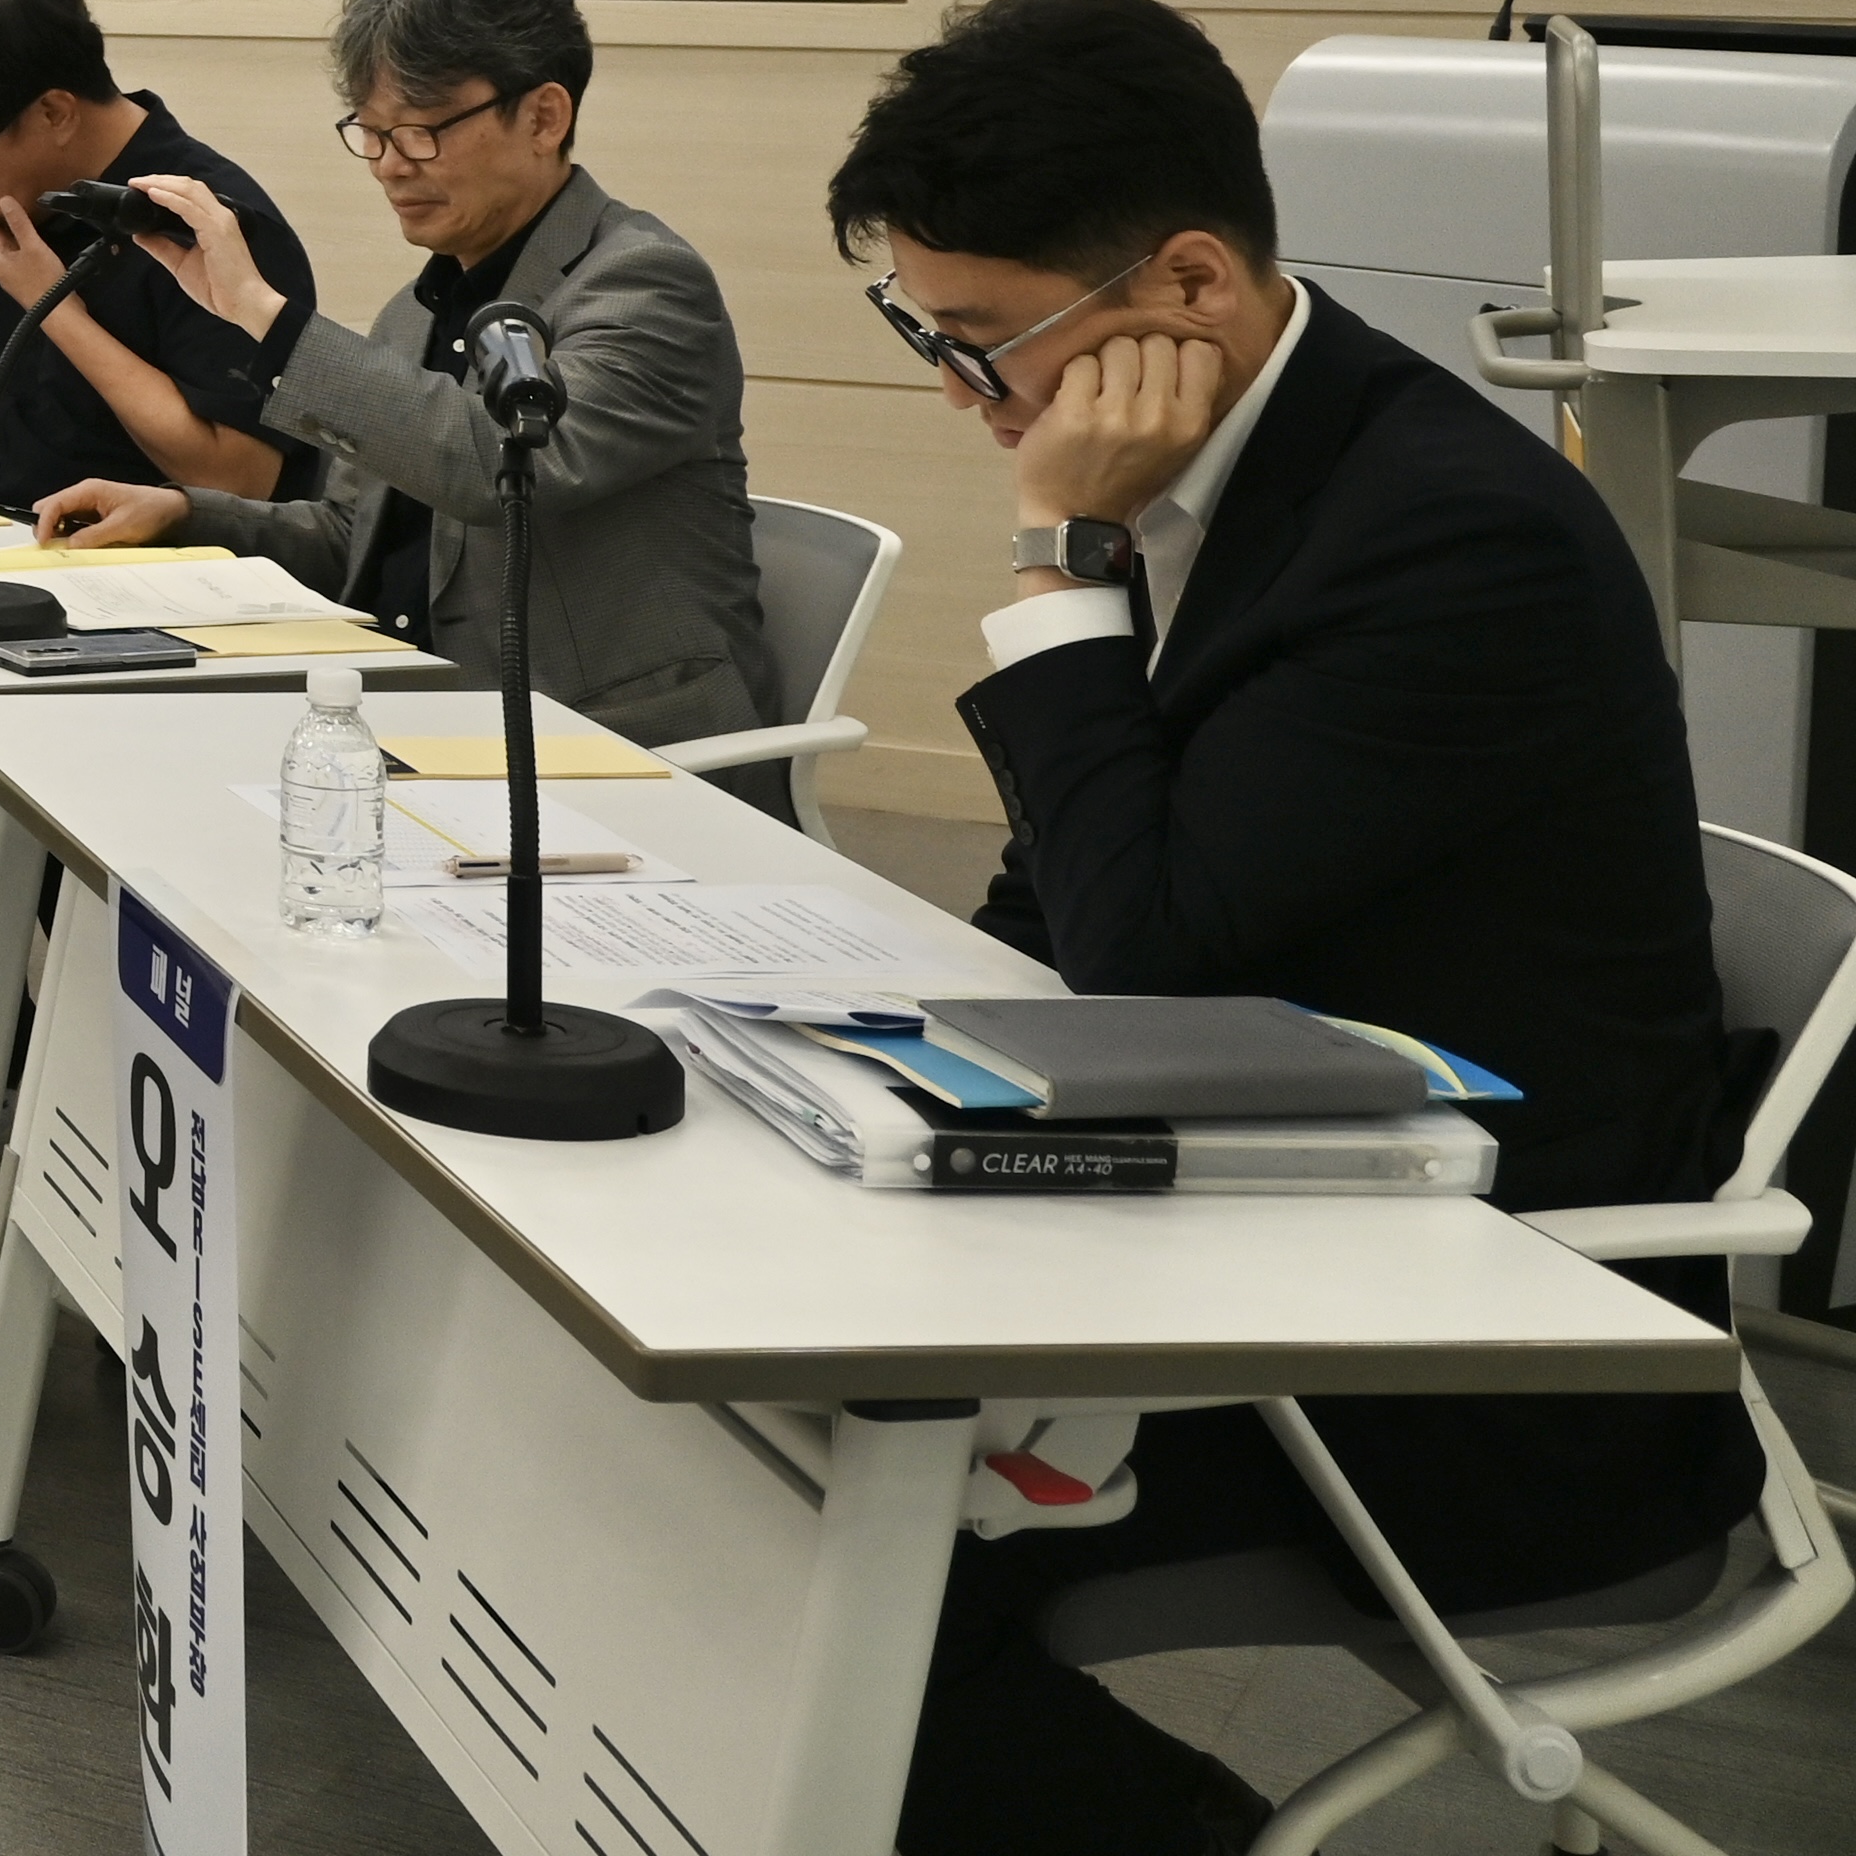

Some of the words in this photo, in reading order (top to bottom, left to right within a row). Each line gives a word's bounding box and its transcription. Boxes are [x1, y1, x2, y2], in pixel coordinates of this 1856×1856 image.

[190, 1109, 207, 1495] 전남RISE센터
[982, 1153, 1058, 1175] CLEAR
[129, 1051, 177, 1802] 오승환
[189, 1504, 207, 1696] 사업부장
